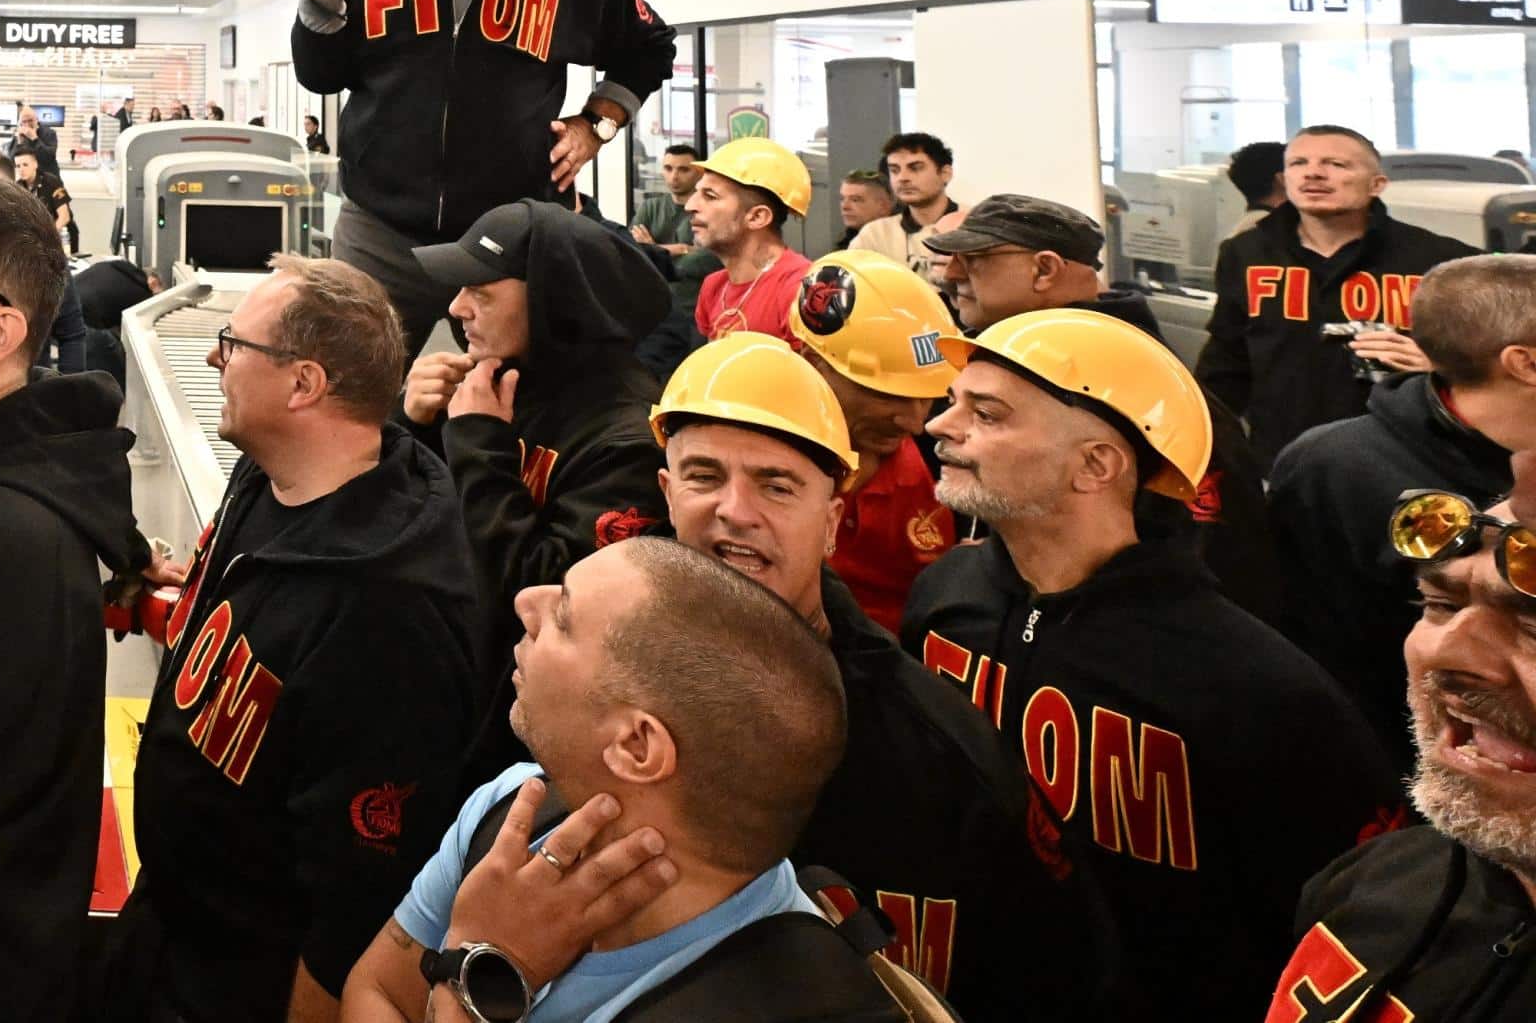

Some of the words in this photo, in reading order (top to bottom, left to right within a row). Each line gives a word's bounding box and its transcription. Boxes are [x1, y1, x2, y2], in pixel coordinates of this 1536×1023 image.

[5, 23, 66, 44] DUTY
[68, 23, 125, 45] FREE
[914, 332, 946, 366] ILV
